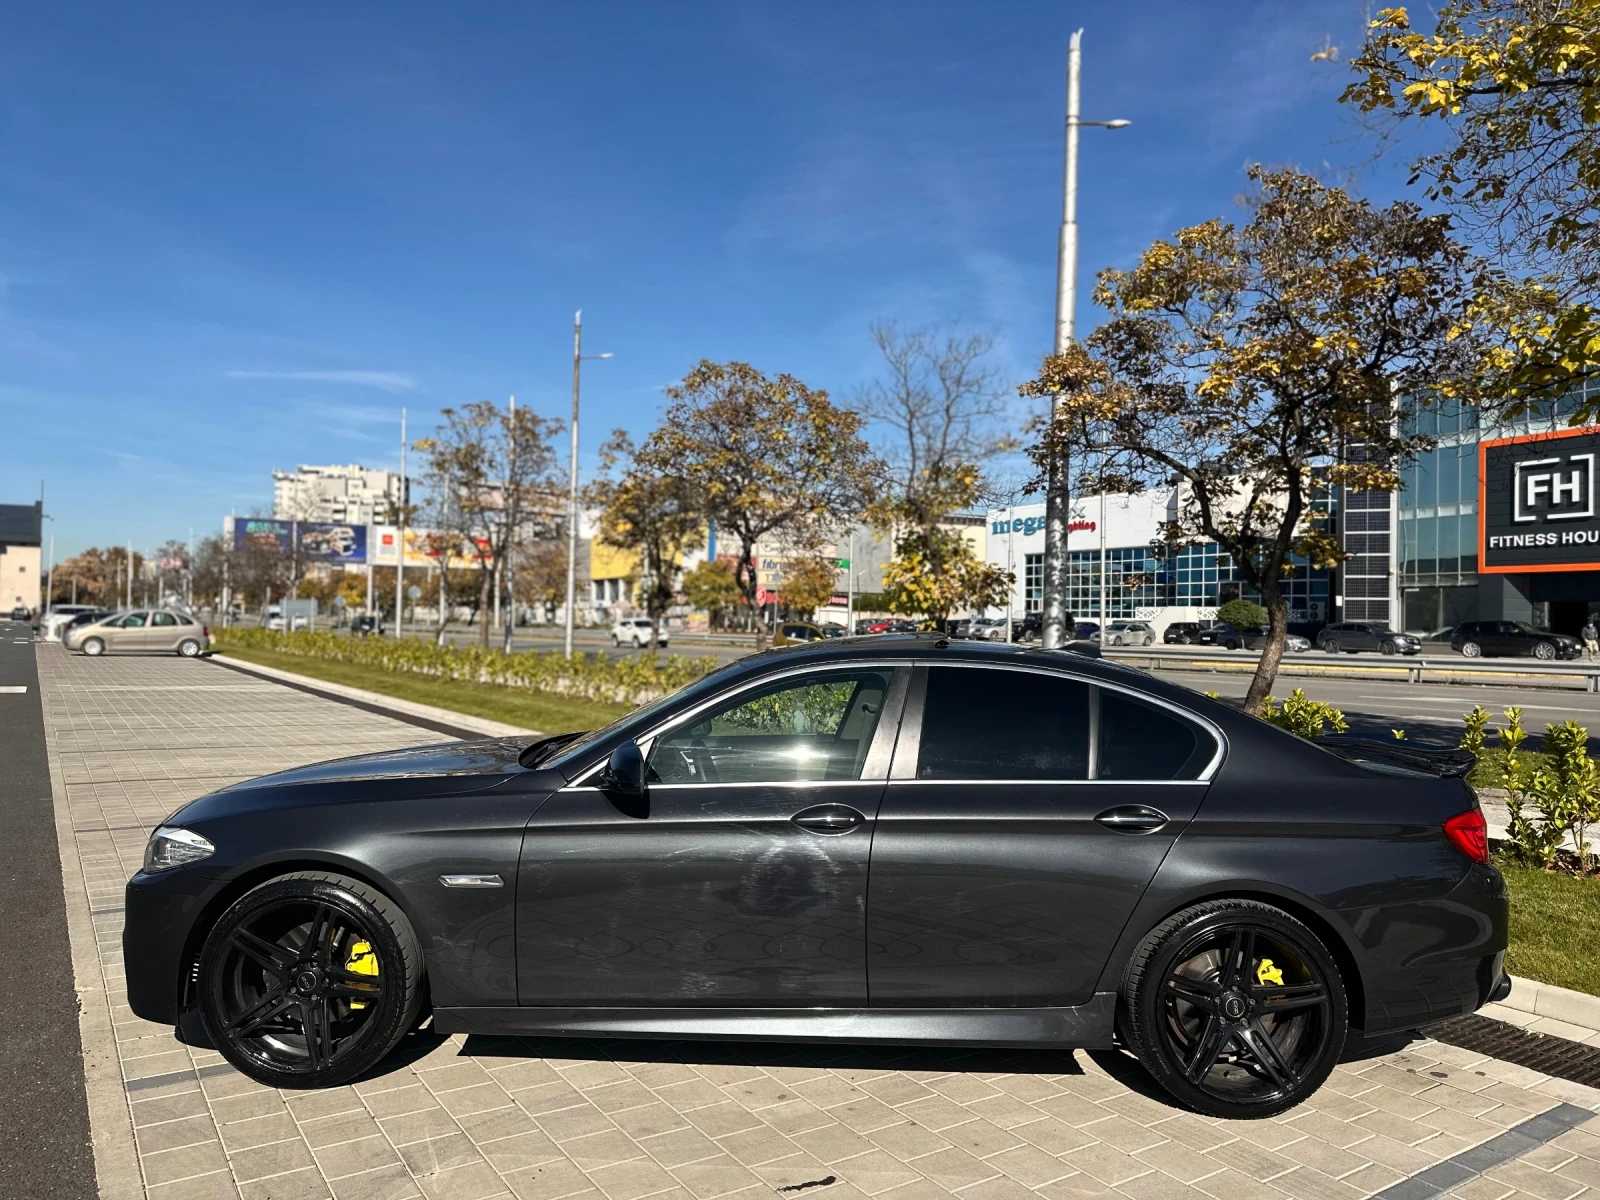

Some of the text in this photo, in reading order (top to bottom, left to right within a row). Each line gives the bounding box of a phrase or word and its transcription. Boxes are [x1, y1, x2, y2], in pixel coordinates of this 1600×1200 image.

[1527, 471, 1580, 506] FH
[1068, 520, 1097, 534] ghting
[1490, 533, 1558, 548] FITNESS
